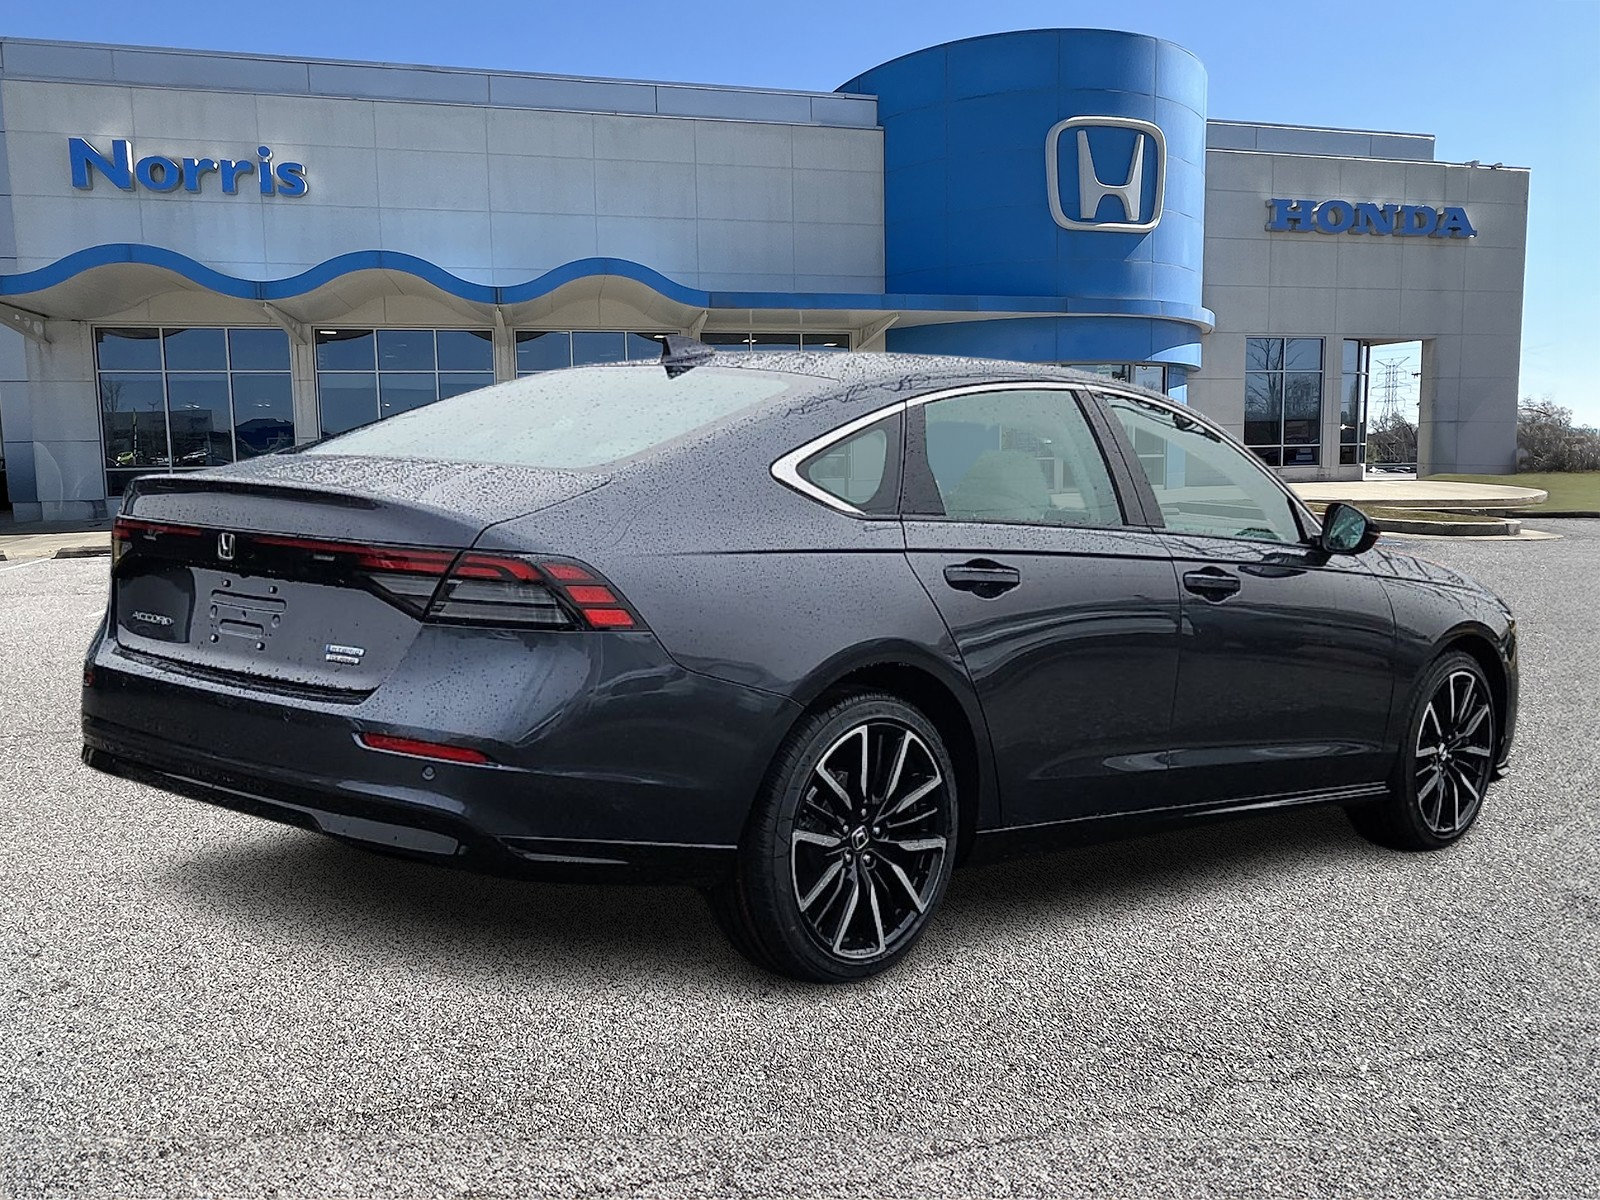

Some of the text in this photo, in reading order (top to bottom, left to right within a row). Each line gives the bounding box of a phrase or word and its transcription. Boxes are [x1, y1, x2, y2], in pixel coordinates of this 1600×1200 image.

[68, 137, 308, 197] Norris
[1266, 198, 1477, 239] HONDA
[132, 610, 174, 626] ACCORD
